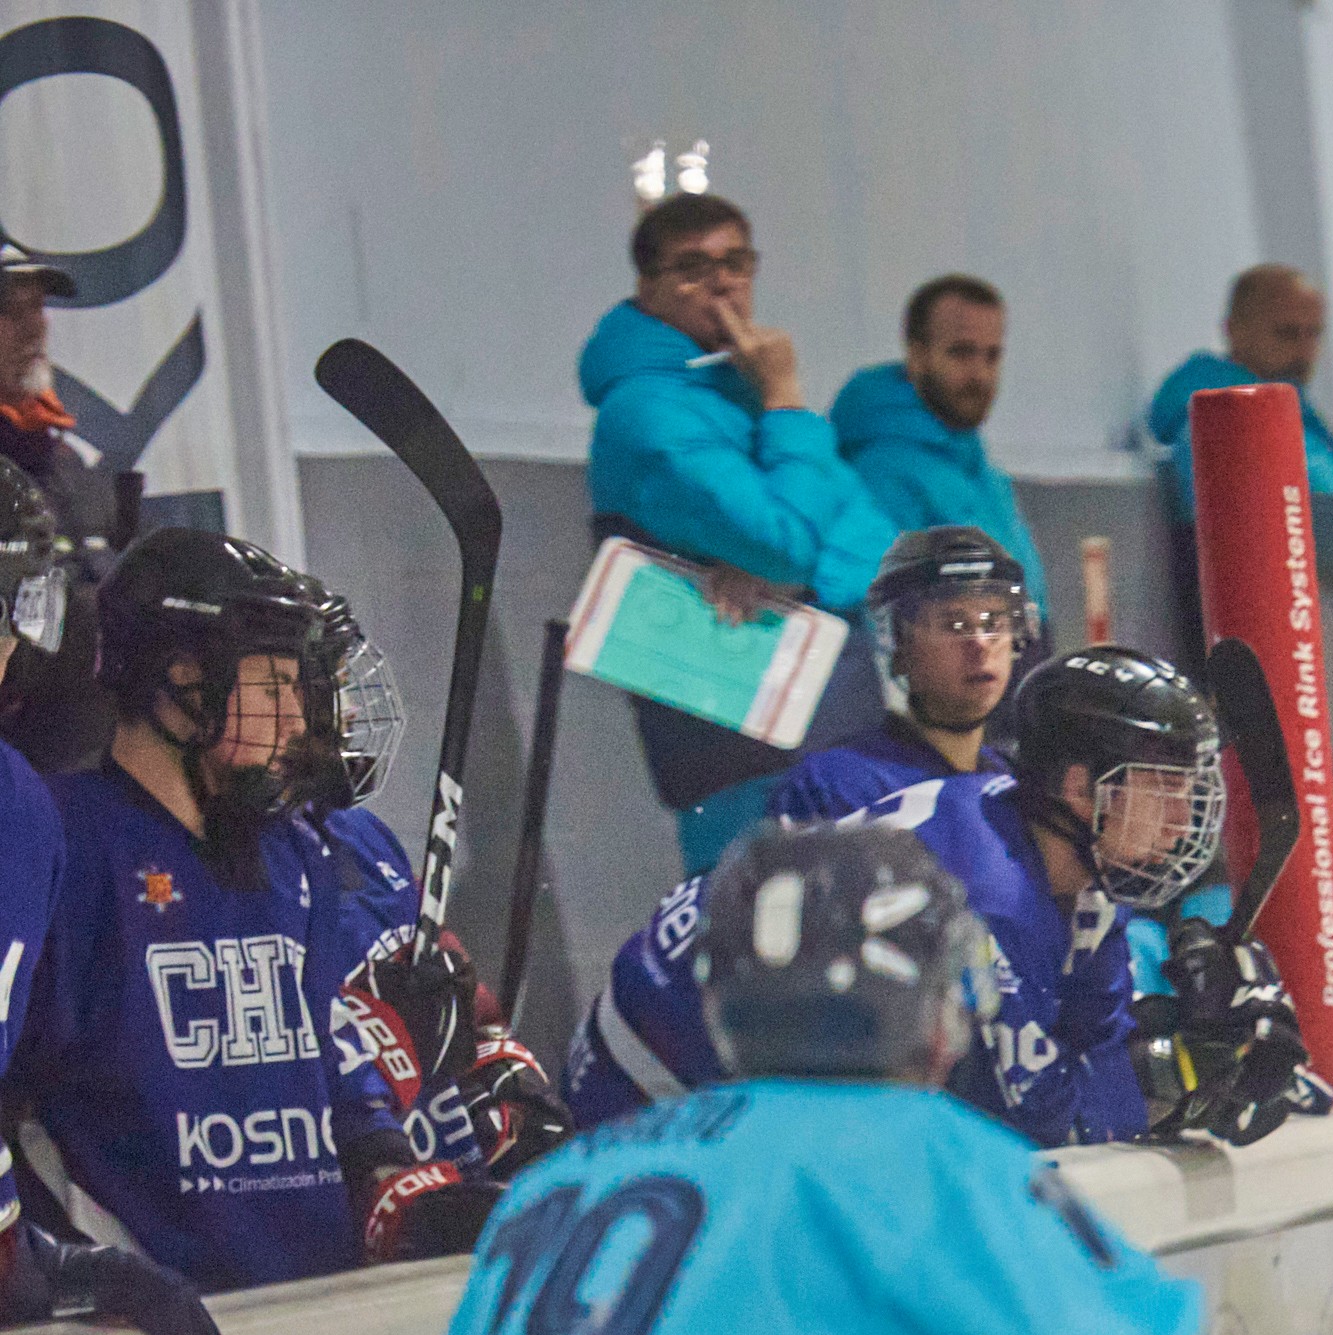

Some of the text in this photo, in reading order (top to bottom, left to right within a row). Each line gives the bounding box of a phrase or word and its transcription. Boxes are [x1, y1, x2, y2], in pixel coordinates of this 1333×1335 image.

[1282, 485, 1313, 631] Systems
[1291, 642, 1320, 719] Rink
[1303, 729, 1327, 784] Ice
